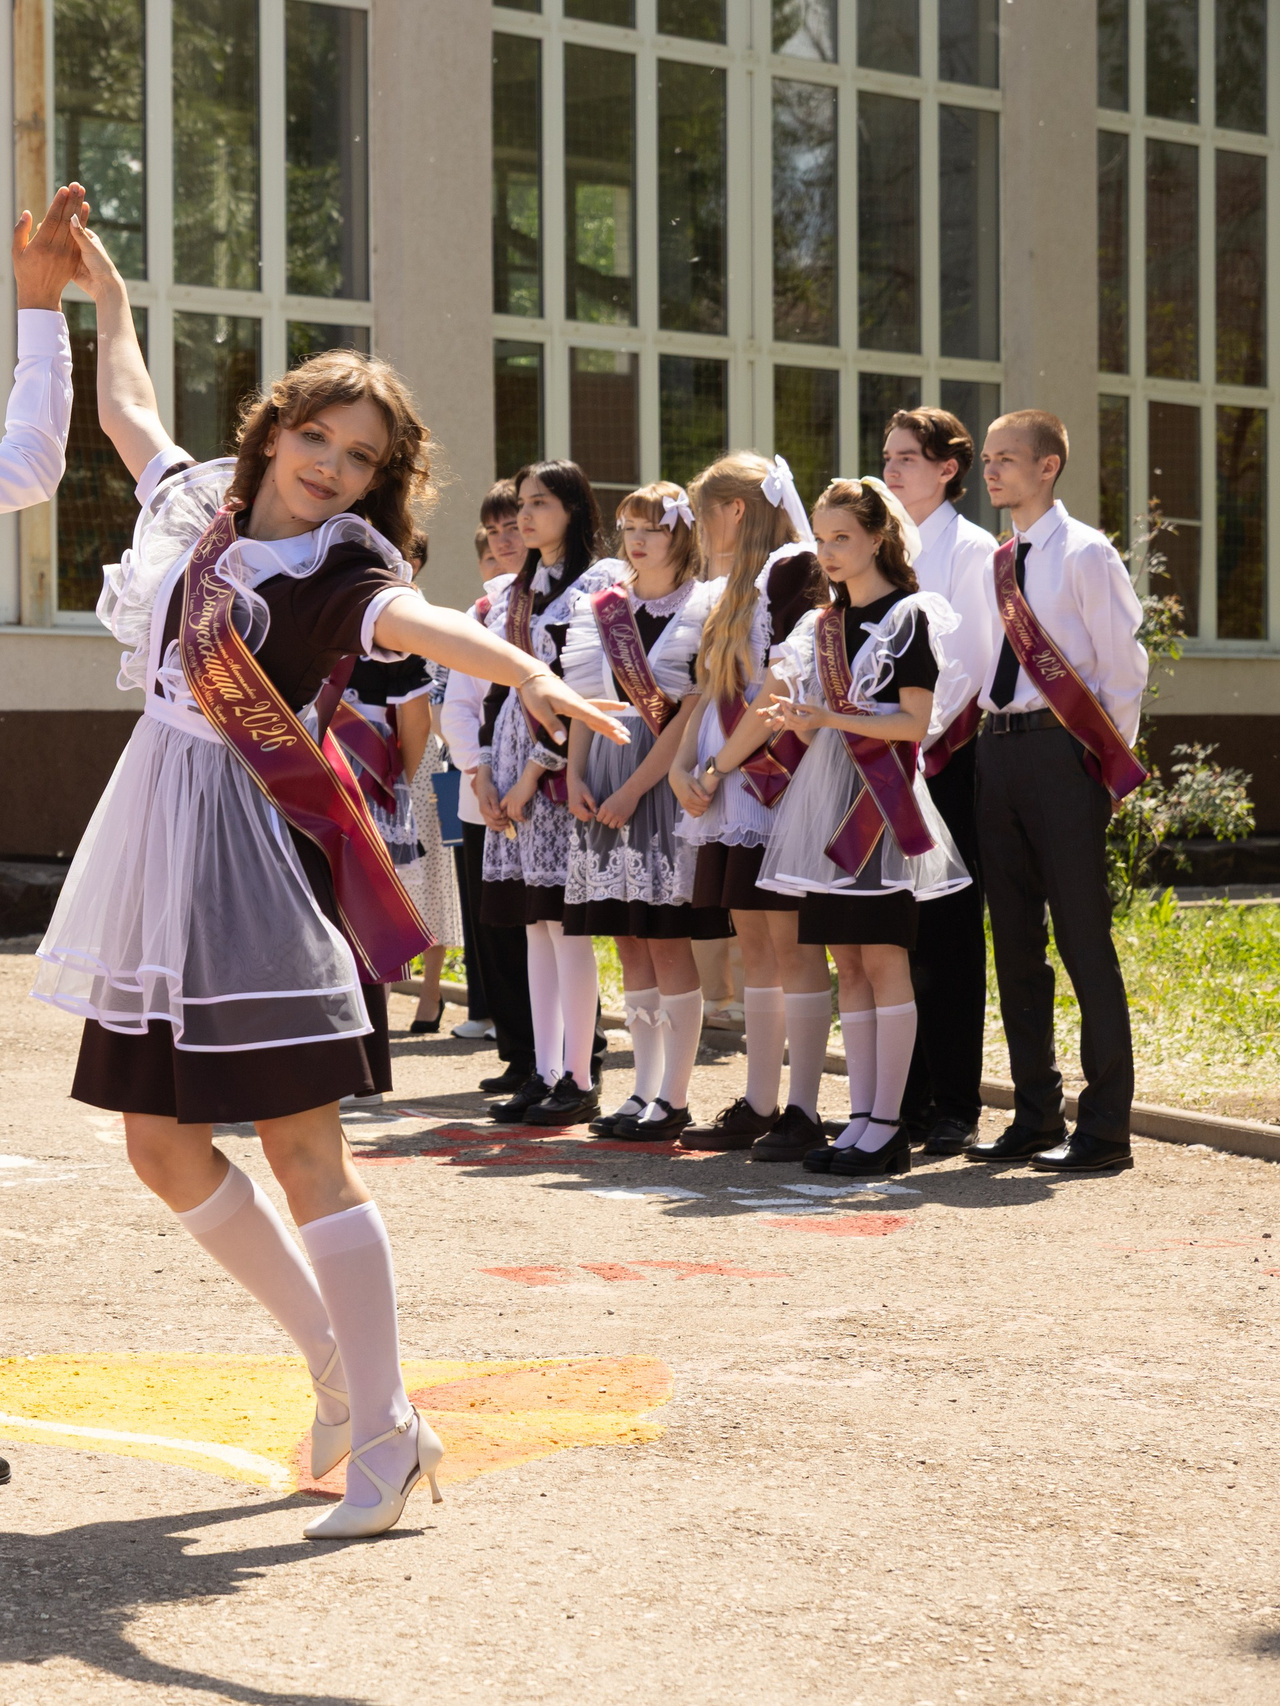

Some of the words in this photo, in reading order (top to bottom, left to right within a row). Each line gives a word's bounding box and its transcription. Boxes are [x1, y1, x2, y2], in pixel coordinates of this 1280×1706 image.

[188, 565, 245, 702] Выпускница
[231, 701, 297, 752] 2026
[609, 623, 647, 696] Выпускница
[819, 616, 844, 697] Выпускница
[1001, 579, 1035, 650] Выпускник
[1032, 649, 1067, 682] 2026
